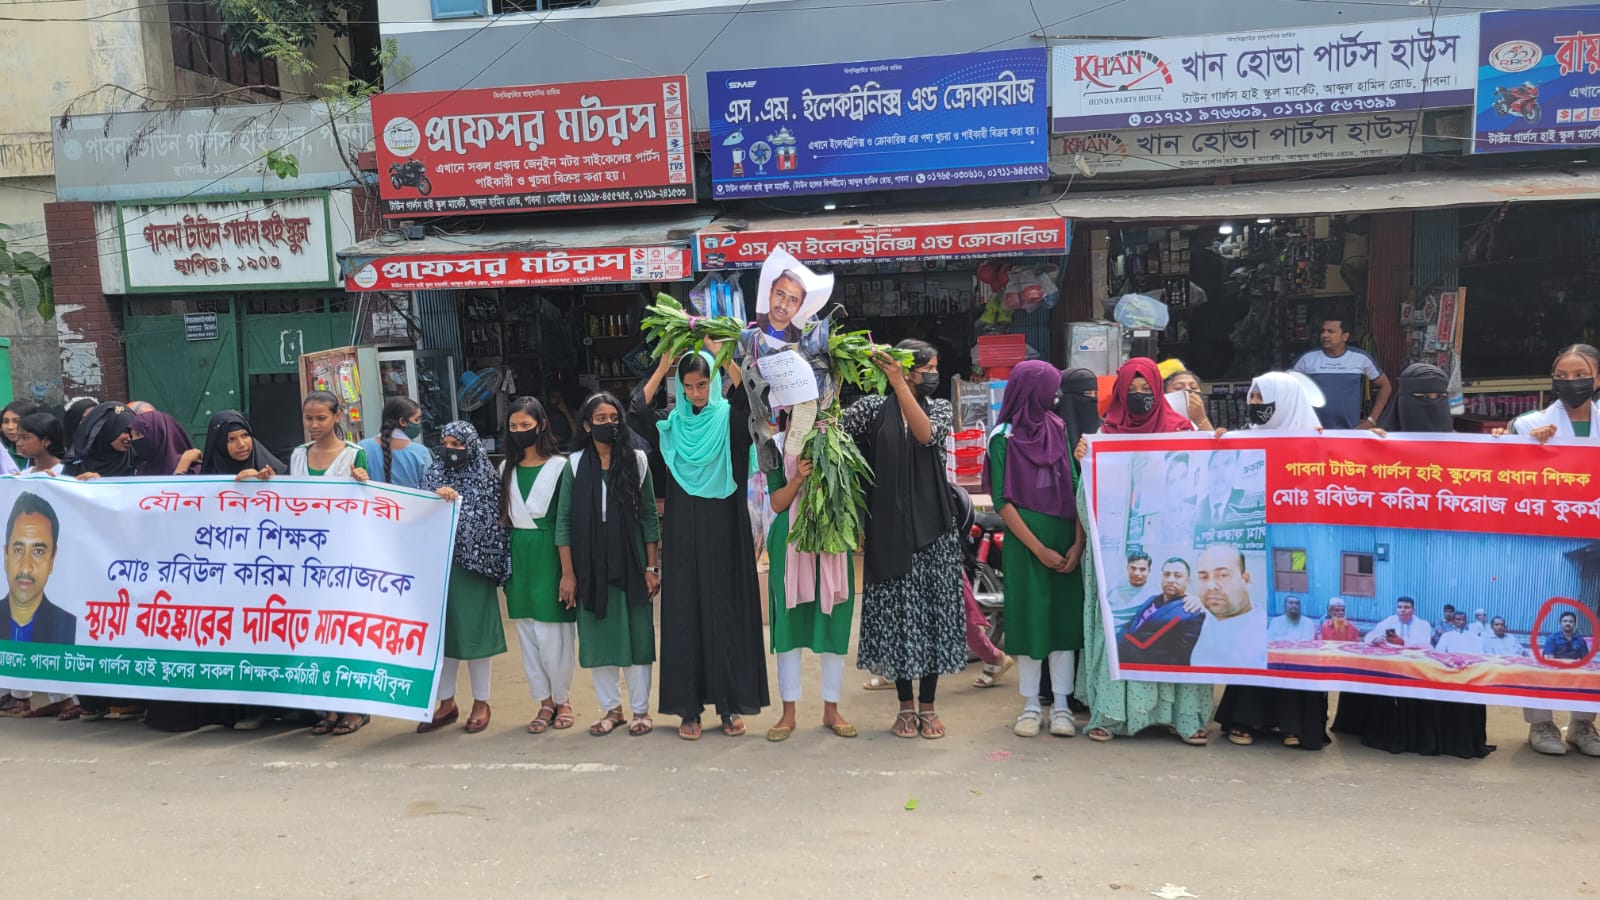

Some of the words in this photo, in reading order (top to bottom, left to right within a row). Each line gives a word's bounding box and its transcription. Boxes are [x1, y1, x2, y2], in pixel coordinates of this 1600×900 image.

[1181, 50, 1228, 82] খান
[1237, 44, 1304, 81] হোন্ডা
[1313, 31, 1382, 72] পার্টস
[1389, 27, 1461, 70] হাউস
[1073, 55, 1142, 88] KHAN
[944, 70, 1036, 110] ক্রোকারীজ
[1088, 97, 1114, 106] HONDA
[1115, 95, 1137, 104] PARTS
[1139, 94, 1161, 103] HOUSE
[1182, 90, 1208, 104] টাউন
[1211, 88, 1237, 103] গার্লস
[1241, 87, 1258, 99] হাই
[1263, 88, 1281, 100] স্কুল
[1285, 82, 1319, 98] মার্কেট,
[1323, 81, 1353, 96] আব্দুল
[1357, 78, 1385, 92] হামিদ
[1389, 78, 1416, 90] রোড,
[425, 110, 545, 154] প্রফেসর
[556, 95, 657, 147] মটরস
[1144, 111, 1192, 124] ০১৭২১
[1199, 104, 1267, 121] ৯৭৬৬০৯,
[1273, 102, 1325, 115] ০১৭১৫
[1331, 97, 1397, 110] ৫৬৭৩৯৯
[1062, 137, 1109, 155] KHAN
[1136, 133, 1183, 155] খান
[1192, 127, 1260, 153] হোন্ডা
[1269, 120, 1339, 148] পার্টস
[1346, 116, 1416, 145] হাউস
[1488, 132, 1510, 145] টাউন
[1513, 129, 1537, 143] গার্লস
[1540, 129, 1556, 142] হাই
[1559, 130, 1575, 143] স্কুল
[436, 162, 465, 174] এখানে
[468, 162, 491, 172] সকল
[494, 160, 520, 171] প্রকার
[524, 155, 556, 170] জেনুইন
[559, 154, 580, 168] মটর
[583, 152, 632, 166] সাইকেলের
[635, 148, 661, 163] পার্টস
[669, 163, 684, 171] TVS
[475, 173, 513, 189] পাইকারী
[518, 178, 525, 186] ও
[528, 174, 551, 189] খুচরা
[554, 171, 580, 184] বিক্রয়
[584, 172, 602, 183] করা
[144, 222, 182, 255] পাবনা
[183, 214, 221, 249] টাউন
[260, 211, 288, 247] হাই
[284, 217, 312, 255] স্কুল
[958, 226, 1059, 249] ক্রোকারিজ
[237, 255, 281, 271] ১৯০৩
[381, 258, 509, 280] প্রফেসর
[520, 251, 626, 275] মটরস
[1285, 461, 1326, 477] পাবনা
[1329, 459, 1367, 479] টাউন
[1371, 461, 1412, 480] গার্লস
[1415, 463, 1443, 482] হাই
[1447, 467, 1493, 486] স্কুলের
[1497, 468, 1538, 485] প্রধান
[1541, 467, 1592, 487] শিক্ষক
[139, 490, 205, 512] যৌন
[216, 490, 406, 521] নিপীড়নকারী
[1272, 488, 1309, 506] মোঃ
[1313, 484, 1375, 508] রবিউল
[1379, 487, 1431, 510] করিম
[1435, 489, 1508, 514] ফিরোজ
[1514, 498, 1546, 516] এর
[195, 524, 251, 550] প্রধান
[257, 519, 330, 551] শিক্ষক
[108, 557, 149, 583] মোঃ
[157, 553, 228, 585] রবিউল
[233, 555, 295, 587] করিম
[301, 556, 415, 597] ফিরোজকে
[85, 587, 130, 641] স্থায়ী
[135, 589, 234, 647] বহিষ্কারের
[242, 593, 312, 651] দাবিতে
[315, 610, 429, 656] মানববন্ধন
[30, 652, 61, 672] পাবনা
[64, 651, 95, 673] টাউন
[98, 653, 131, 675] গার্লস
[134, 655, 158, 677] হাই
[160, 660, 196, 683] স্কুলের
[200, 662, 235, 681] সকল
[239, 659, 320, 687] শিক্ষক-কর্মচারী
[322, 671, 331, 685] ও
[335, 664, 414, 700] শিক্ষার্থীবৃন্দ
